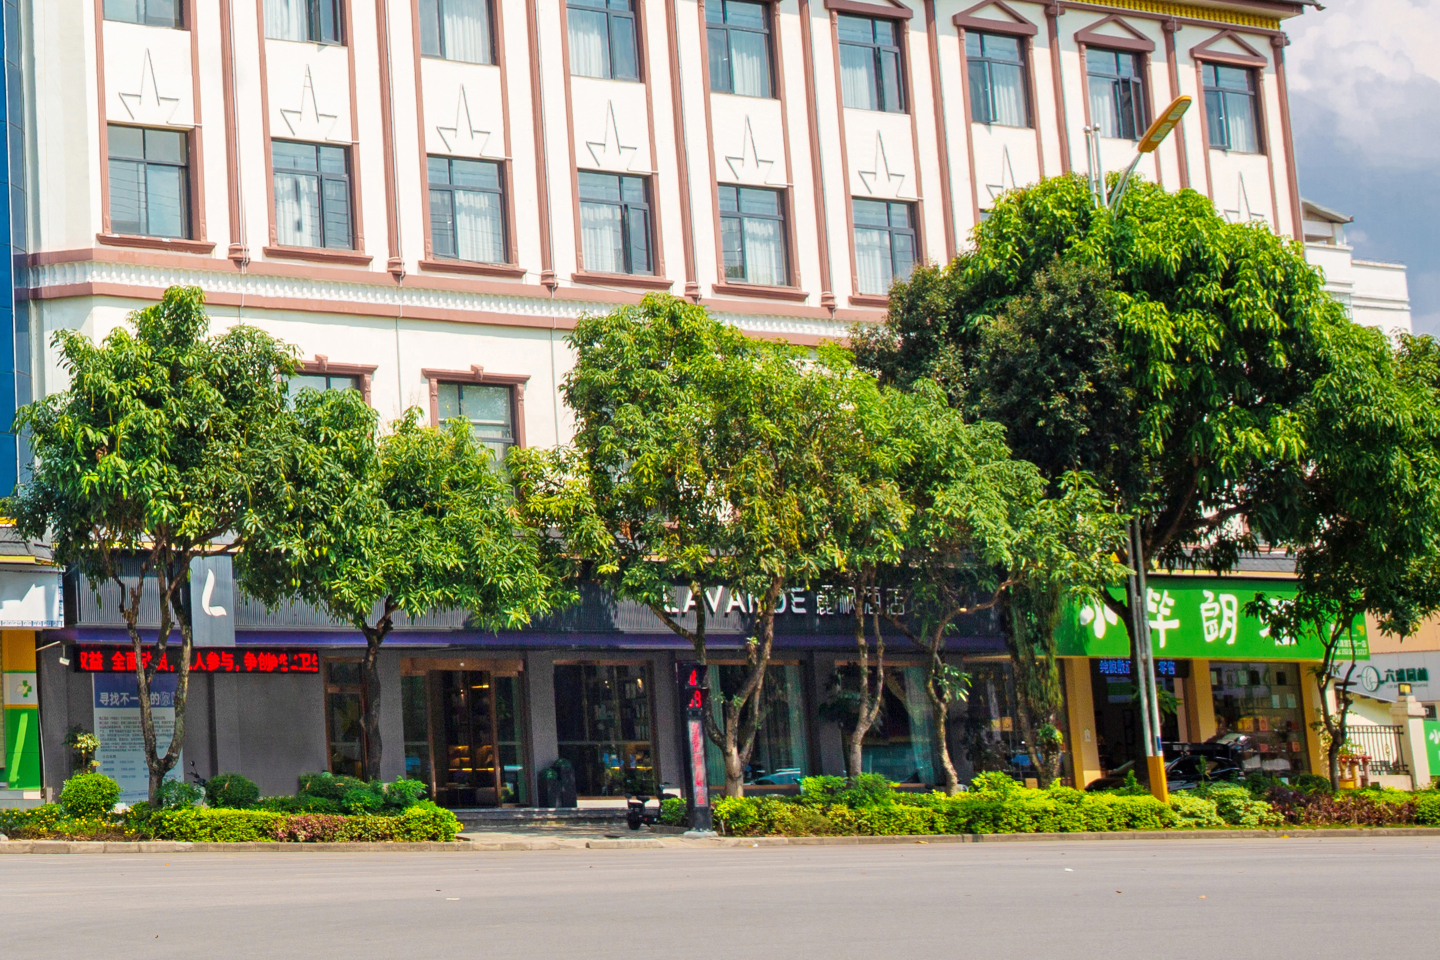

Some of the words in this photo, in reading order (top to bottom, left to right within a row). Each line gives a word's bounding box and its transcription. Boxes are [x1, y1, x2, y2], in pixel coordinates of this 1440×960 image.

[99, 692, 176, 706] 寻找不一的你
